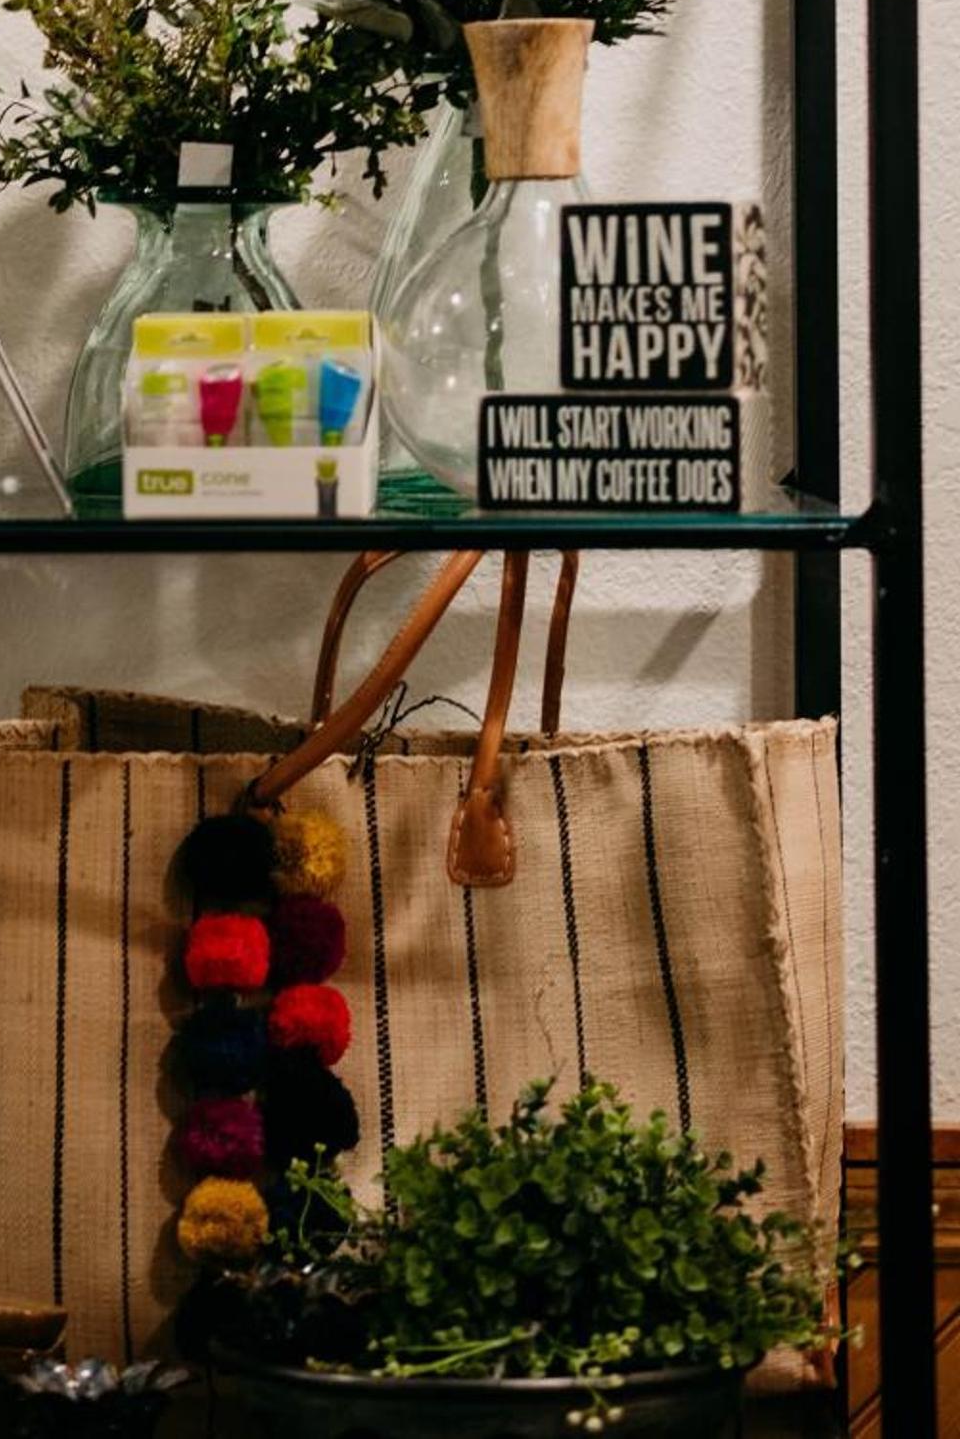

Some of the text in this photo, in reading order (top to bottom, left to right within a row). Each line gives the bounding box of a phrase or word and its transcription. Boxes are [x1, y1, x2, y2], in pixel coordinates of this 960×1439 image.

[567, 214, 724, 287] WINE
[570, 286, 725, 323] MAKES ME
[572, 323, 726, 379] HAPPY
[487, 405, 732, 450] I WILL START WORKING
[141, 471, 251, 493] true cone
[487, 457, 732, 503] WHEN MY COFFEE DOES
